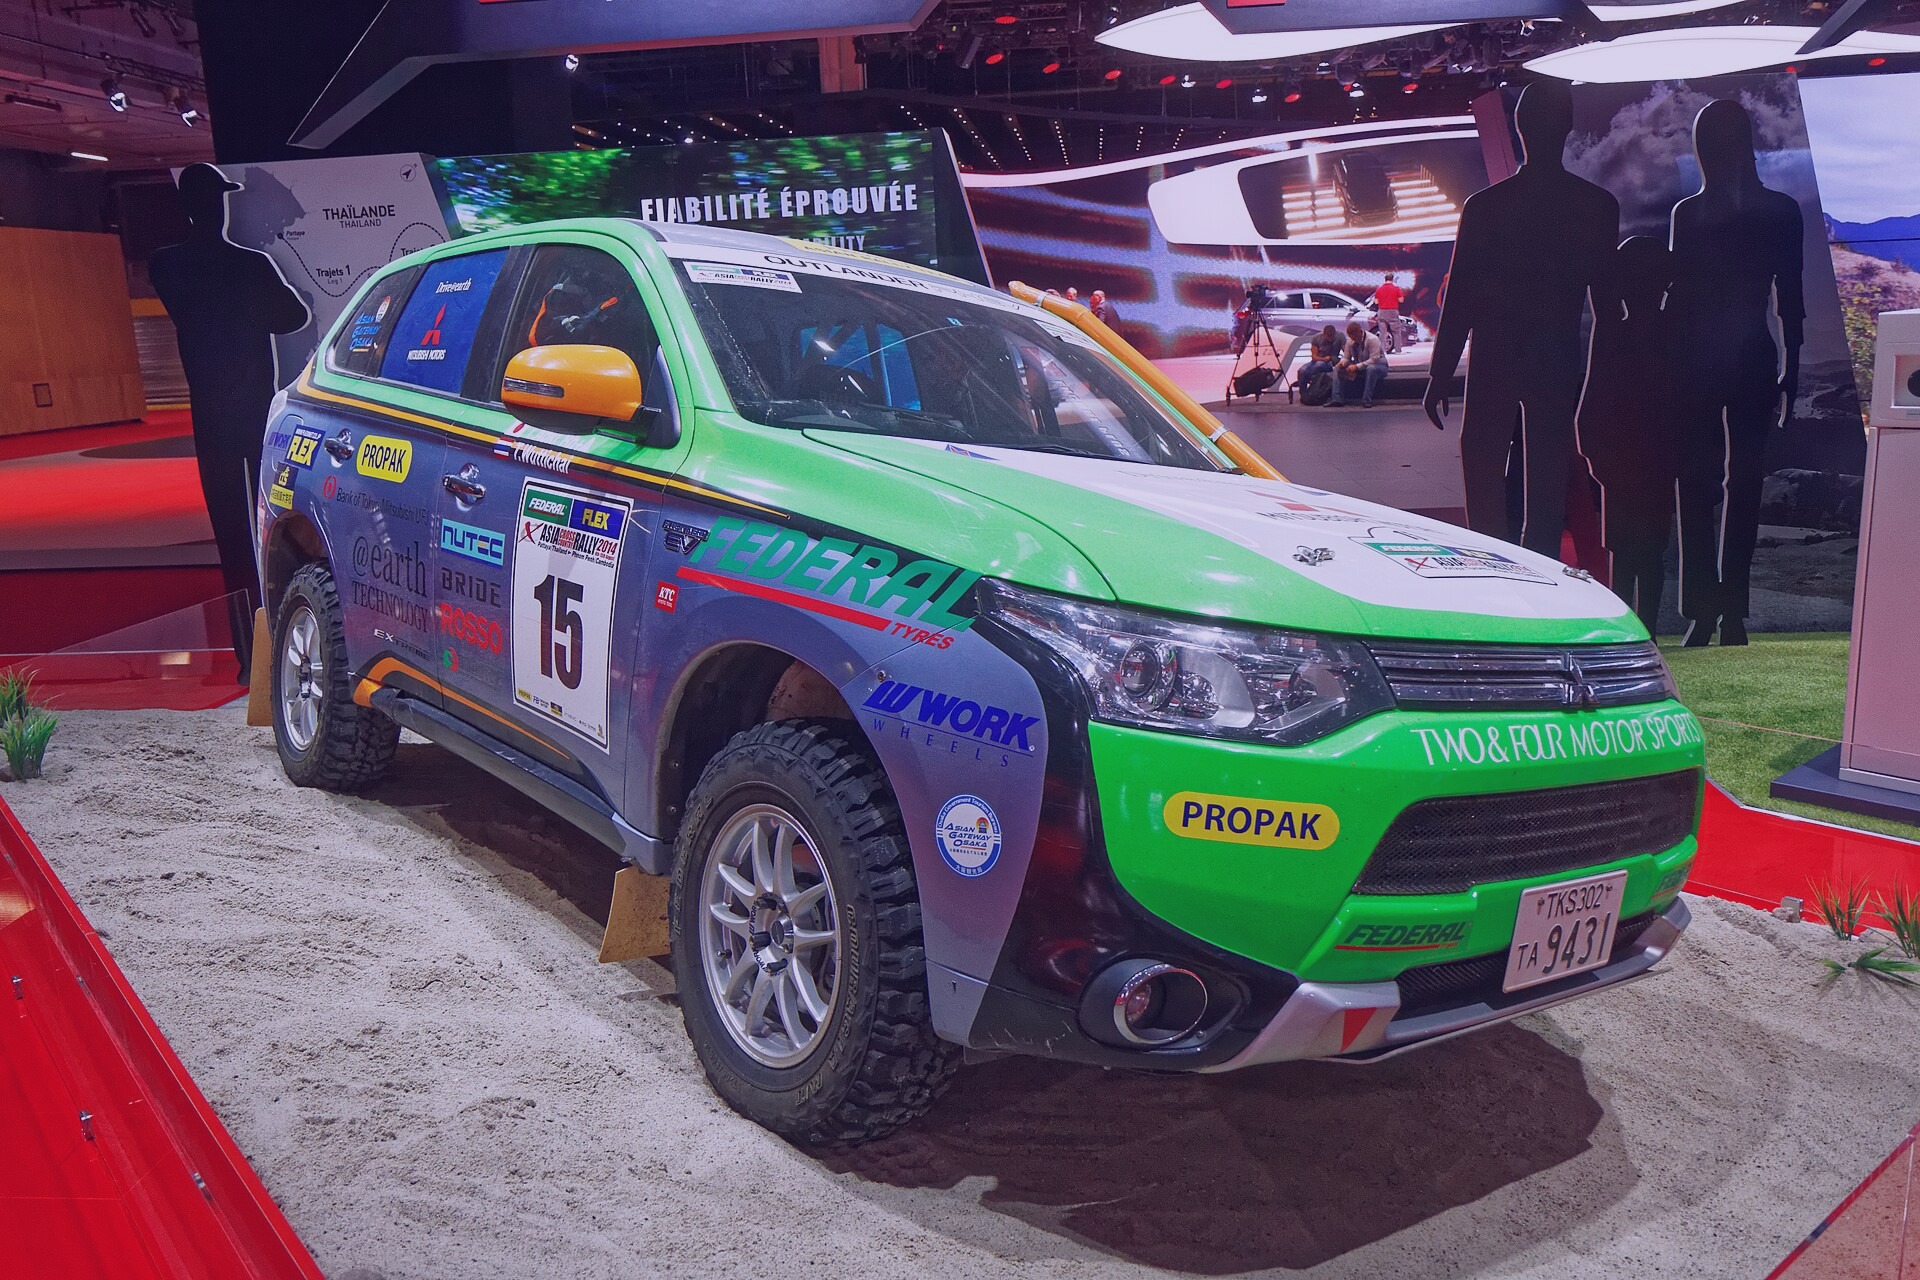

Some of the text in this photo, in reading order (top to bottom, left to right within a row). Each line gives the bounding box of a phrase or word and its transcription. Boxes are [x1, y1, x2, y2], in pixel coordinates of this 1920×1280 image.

[323, 204, 396, 221] THAÏLANDE
[641, 180, 918, 223] FIABILITÉ ÉPROUVÉE
[339, 218, 382, 229] THAILAND
[316, 264, 351, 279] Trajets 1
[764, 255, 929, 290] OUTLANDER
[286, 435, 318, 466] FLEX
[361, 443, 406, 474] PROPAK
[336, 487, 354, 504] Bank
[529, 497, 565, 516] FEDERAL
[560, 528, 575, 541] CROSS
[582, 508, 610, 531] FLEX
[540, 524, 618, 556] ASIA RALLY 2014
[353, 536, 428, 598] @earth
[688, 515, 986, 650] FEDERAL TYRES
[441, 567, 501, 608] BRIDE
[659, 586, 675, 601] KTC
[352, 580, 428, 633] TECHNOLOGY
[441, 602, 503, 655] ROSSO
[534, 574, 584, 689] 15
[918, 689, 1041, 751] WORK
[1569, 718, 1648, 757] MOTOR
[1646, 712, 1701, 749] SPORTS
[873, 718, 1009, 768] WHEELS
[944, 822, 975, 832] ASIAN
[949, 831, 992, 841] GATEWAY
[1182, 801, 1321, 841] PROPAK
[953, 839, 987, 848] OSAKA
[1547, 883, 1604, 920] TKS302
[1344, 921, 1467, 946] FEDERAL
[1518, 912, 1611, 974] TA 9431
